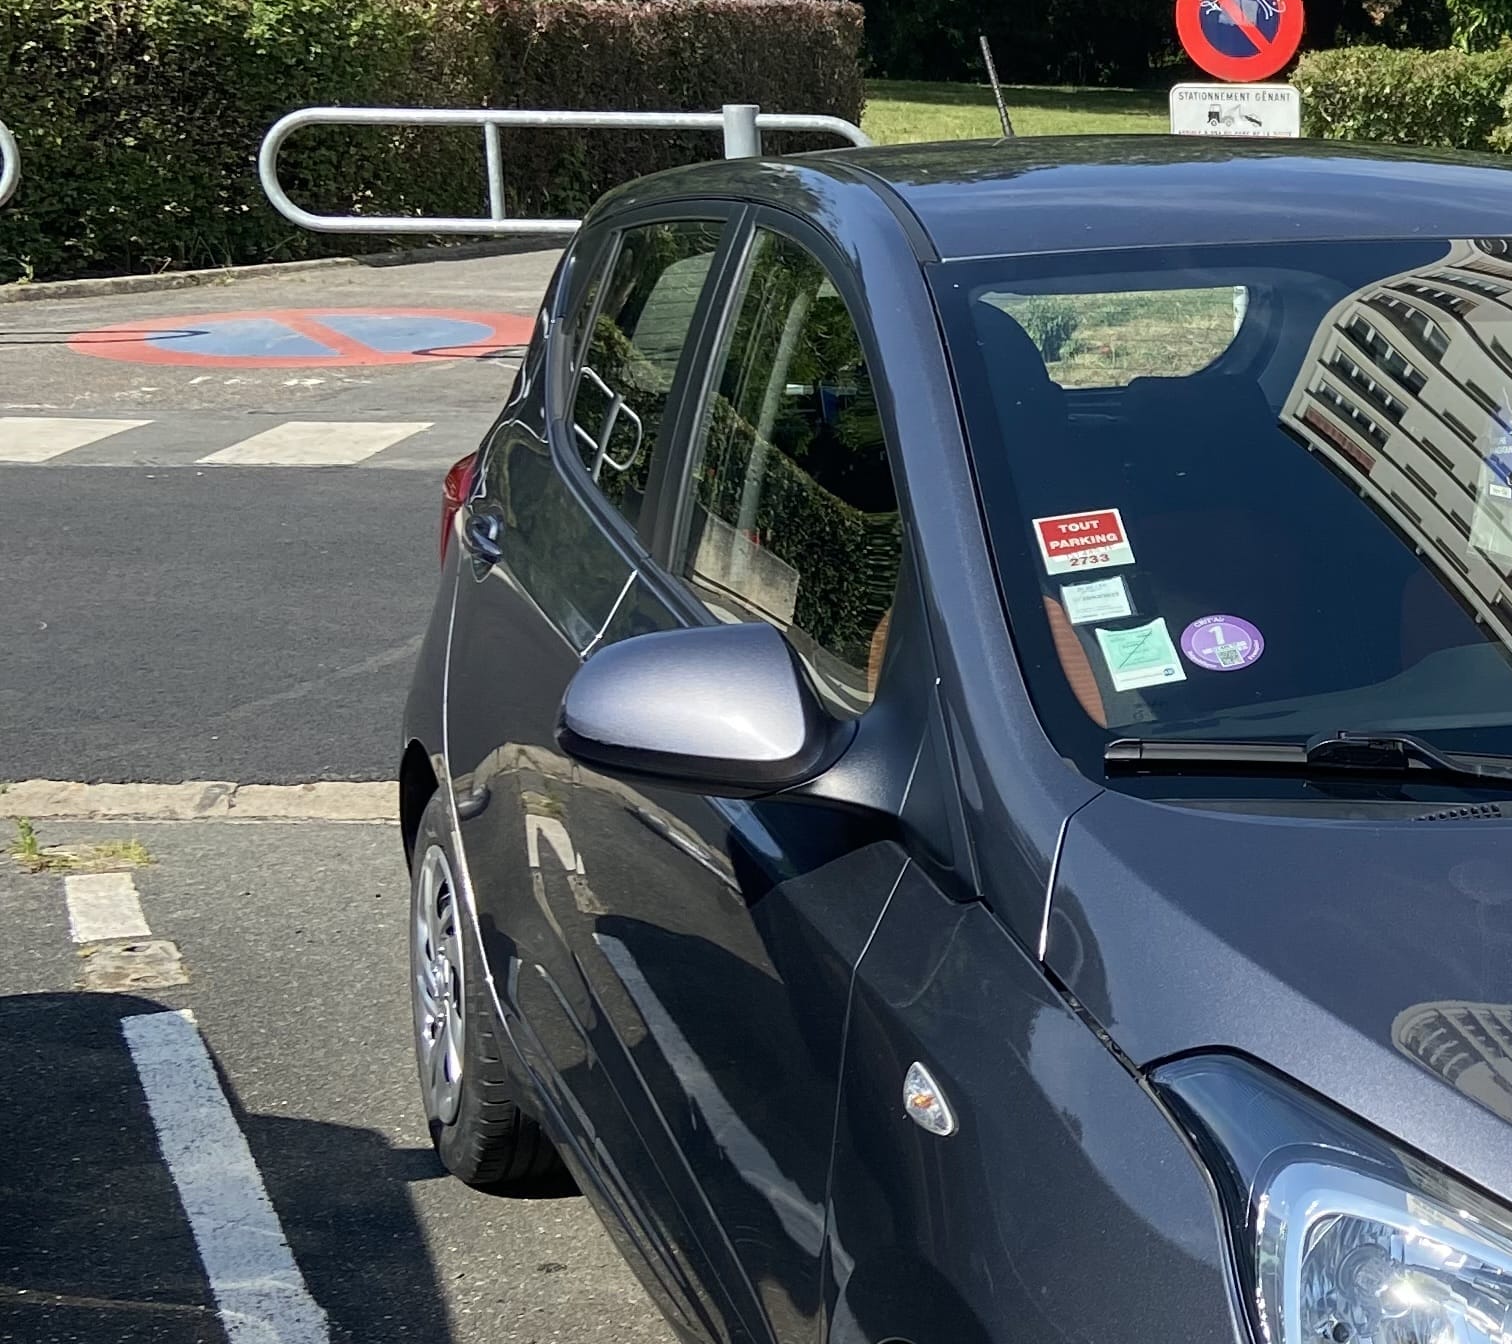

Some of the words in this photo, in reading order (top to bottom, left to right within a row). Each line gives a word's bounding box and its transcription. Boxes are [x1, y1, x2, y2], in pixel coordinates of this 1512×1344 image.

[1178, 91, 1250, 101] STATIONNEMENT
[1255, 90, 1291, 102] GÊNANT
[1058, 520, 1100, 533] TOUT
[1049, 533, 1118, 550] PARKING
[1069, 553, 1110, 567] 2733
[1208, 625, 1225, 645] 1
